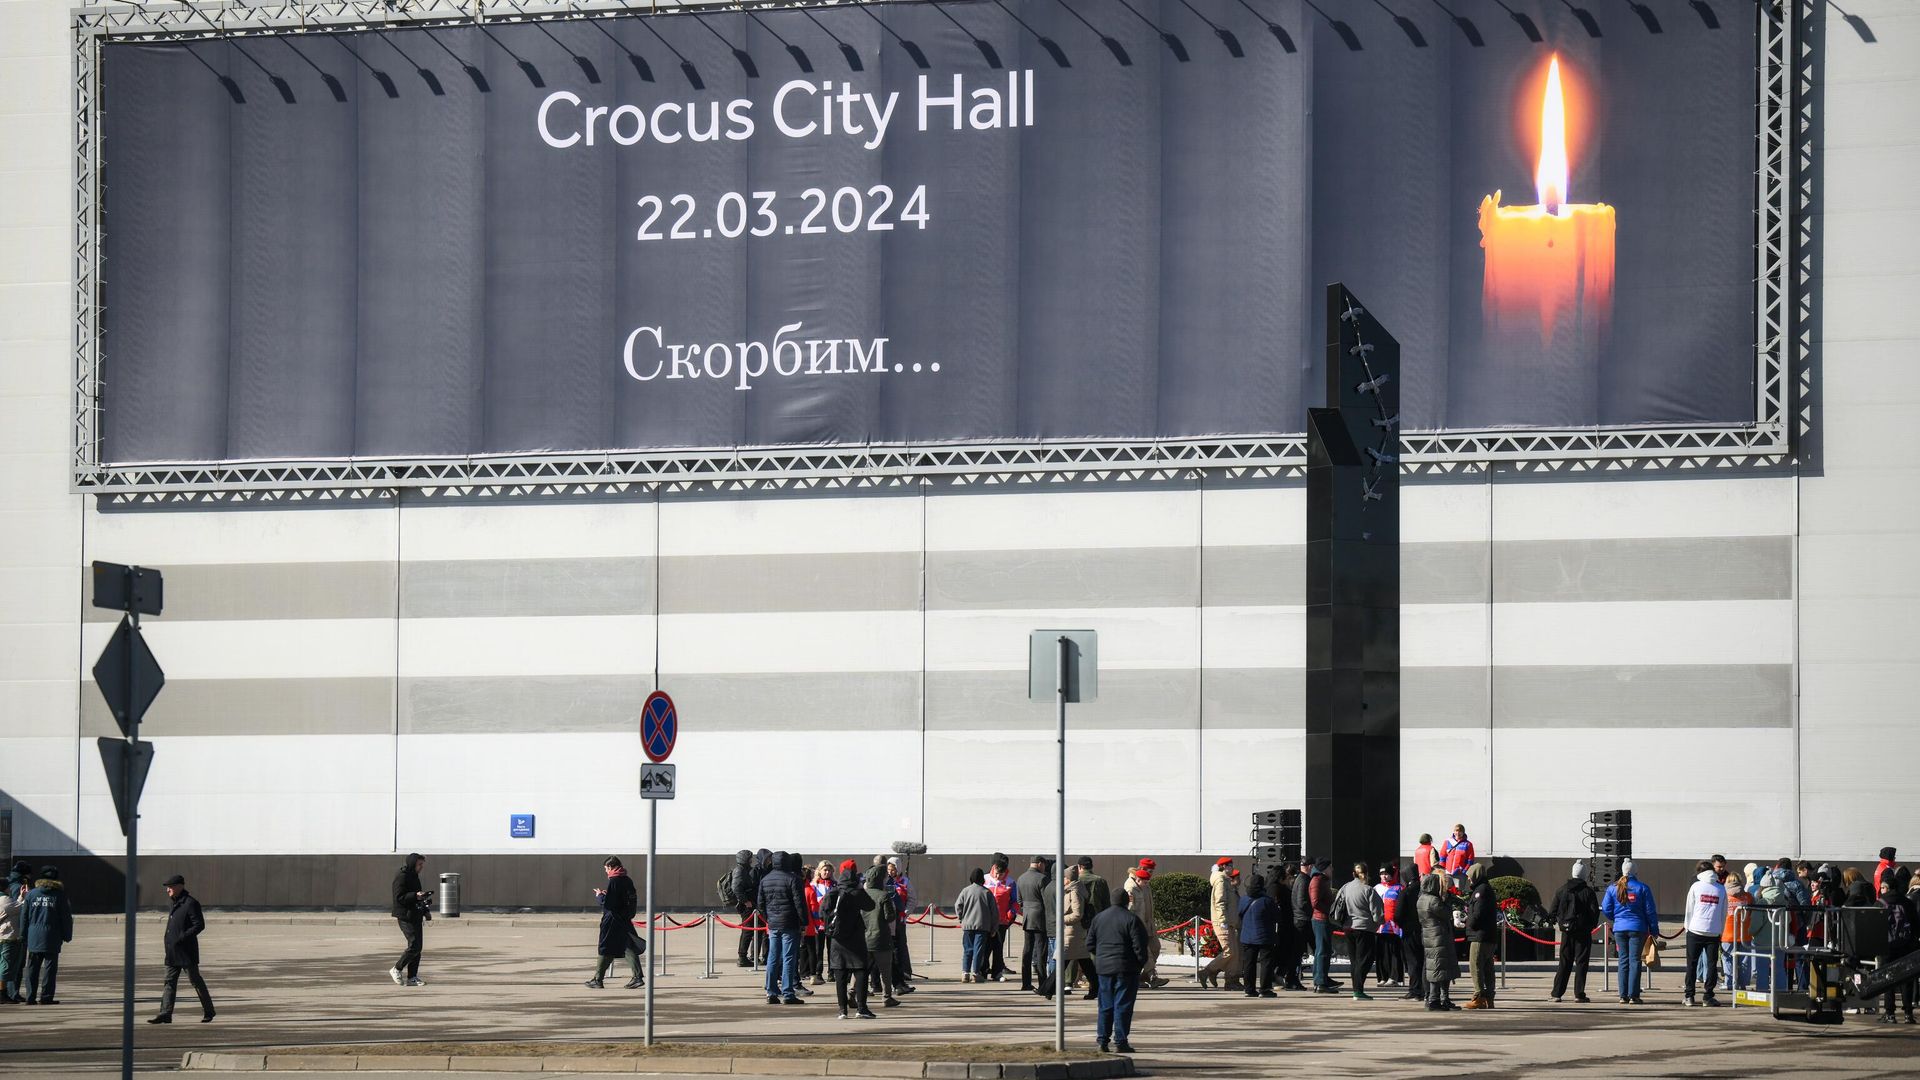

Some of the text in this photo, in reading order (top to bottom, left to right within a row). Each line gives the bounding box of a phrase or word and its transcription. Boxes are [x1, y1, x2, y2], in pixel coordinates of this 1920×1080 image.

[537, 69, 1034, 150] Crocus City Hall
[637, 184, 930, 241] 22.03.2024
[623, 321, 941, 391] Скорбим...
